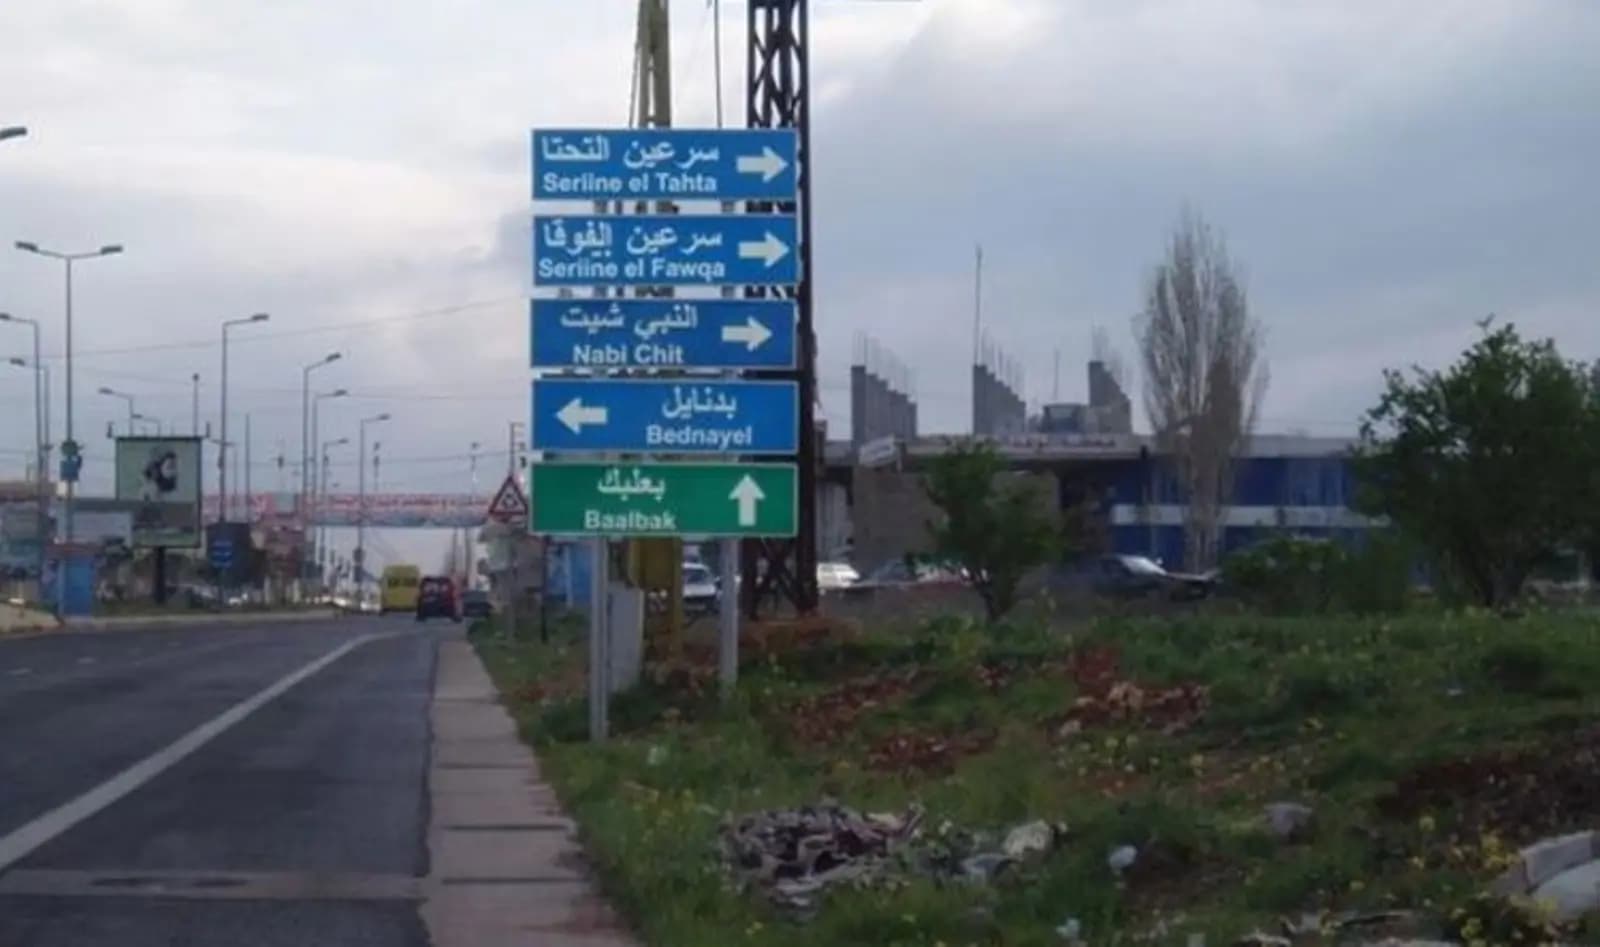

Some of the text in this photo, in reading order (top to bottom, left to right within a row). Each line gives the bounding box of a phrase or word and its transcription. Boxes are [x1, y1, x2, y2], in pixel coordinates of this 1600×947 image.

[541, 134, 611, 162] التحتا
[628, 173, 649, 193] el
[655, 173, 718, 193] Tahta
[624, 258, 645, 279] el
[651, 258, 726, 283] Fawqa
[560, 303, 698, 339] النبي شيت
[572, 345, 685, 364] Nabi Chit
[662, 386, 738, 420] بدنايل
[646, 425, 753, 450] Bednayel
[597, 468, 666, 503] بعلبك
[584, 510, 676, 531] Baalbak
